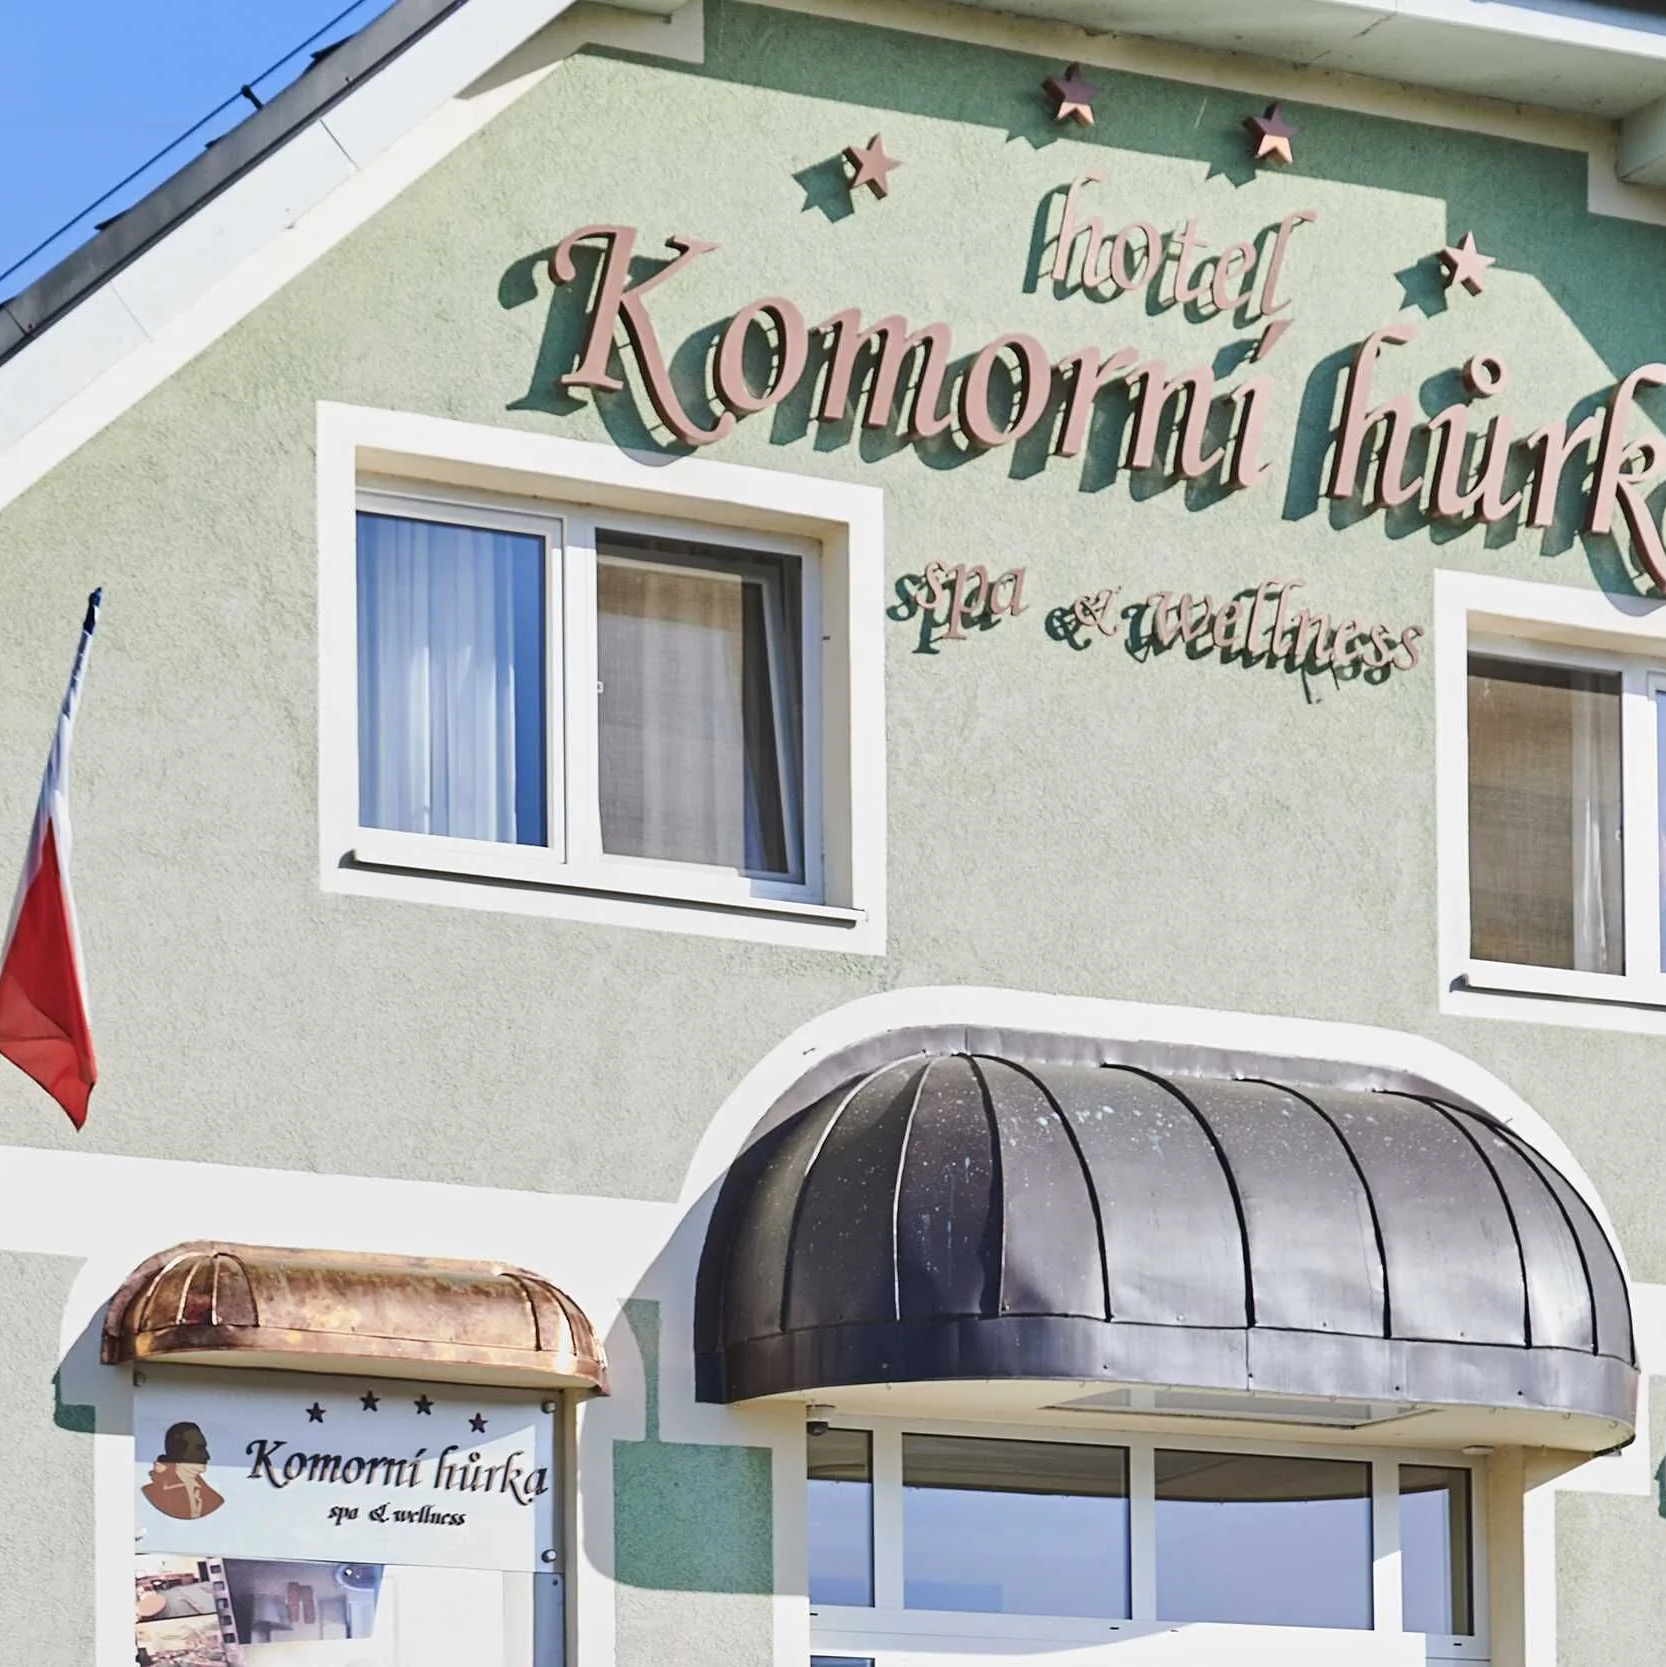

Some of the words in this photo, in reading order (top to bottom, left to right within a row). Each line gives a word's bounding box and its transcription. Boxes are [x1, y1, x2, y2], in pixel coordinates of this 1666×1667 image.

[1050, 170, 1317, 320] hotel
[547, 223, 1295, 489] Komorní
[914, 559, 1029, 641] spa
[1073, 584, 1123, 637] &
[1148, 577, 1425, 671] wellness
[245, 1439, 427, 1489] Komorní
[433, 1445, 549, 1506] hůrka
[327, 1505, 360, 1527] spa
[368, 1501, 391, 1524] &
[392, 1503, 468, 1527] wellness
